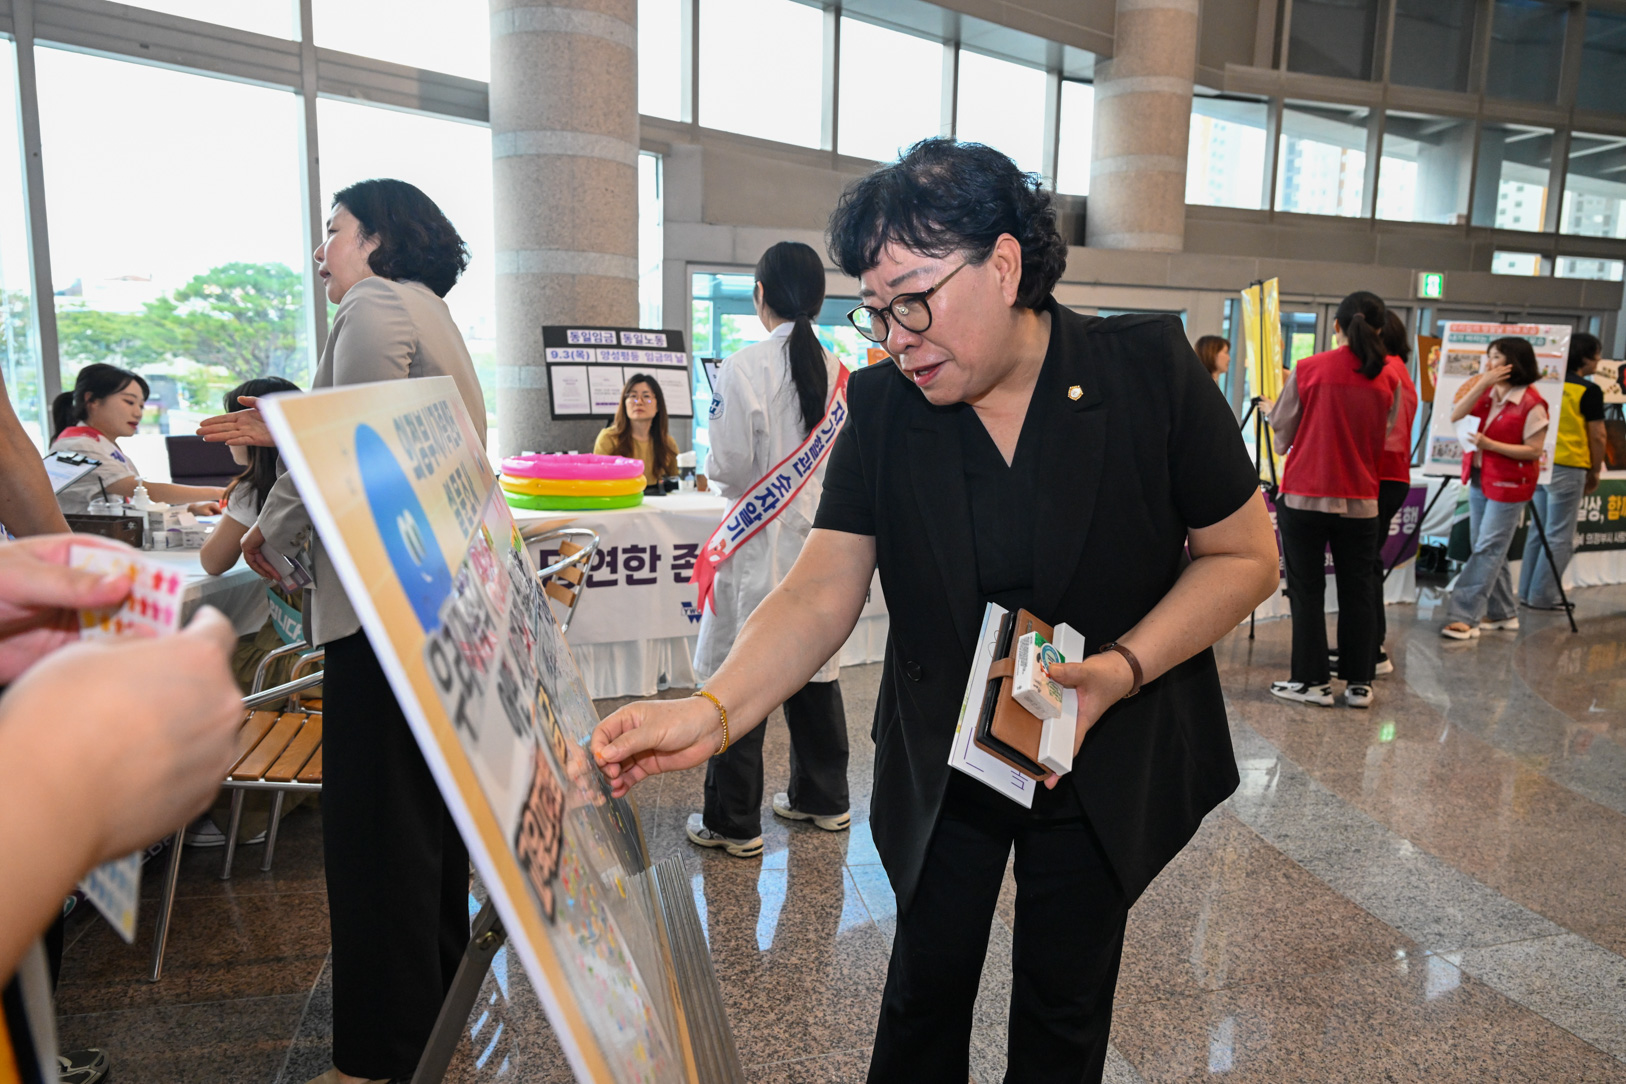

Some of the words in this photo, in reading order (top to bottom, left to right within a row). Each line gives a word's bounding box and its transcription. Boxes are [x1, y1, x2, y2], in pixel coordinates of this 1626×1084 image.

[570, 331, 614, 343] 동일임금
[623, 333, 664, 346] 동일노동
[600, 350, 639, 361] 양성평등
[645, 352, 673, 363] 임금의
[675, 354, 684, 364] 날
[792, 400, 846, 478] 자기혈관
[726, 473, 792, 542] 숫자알기
